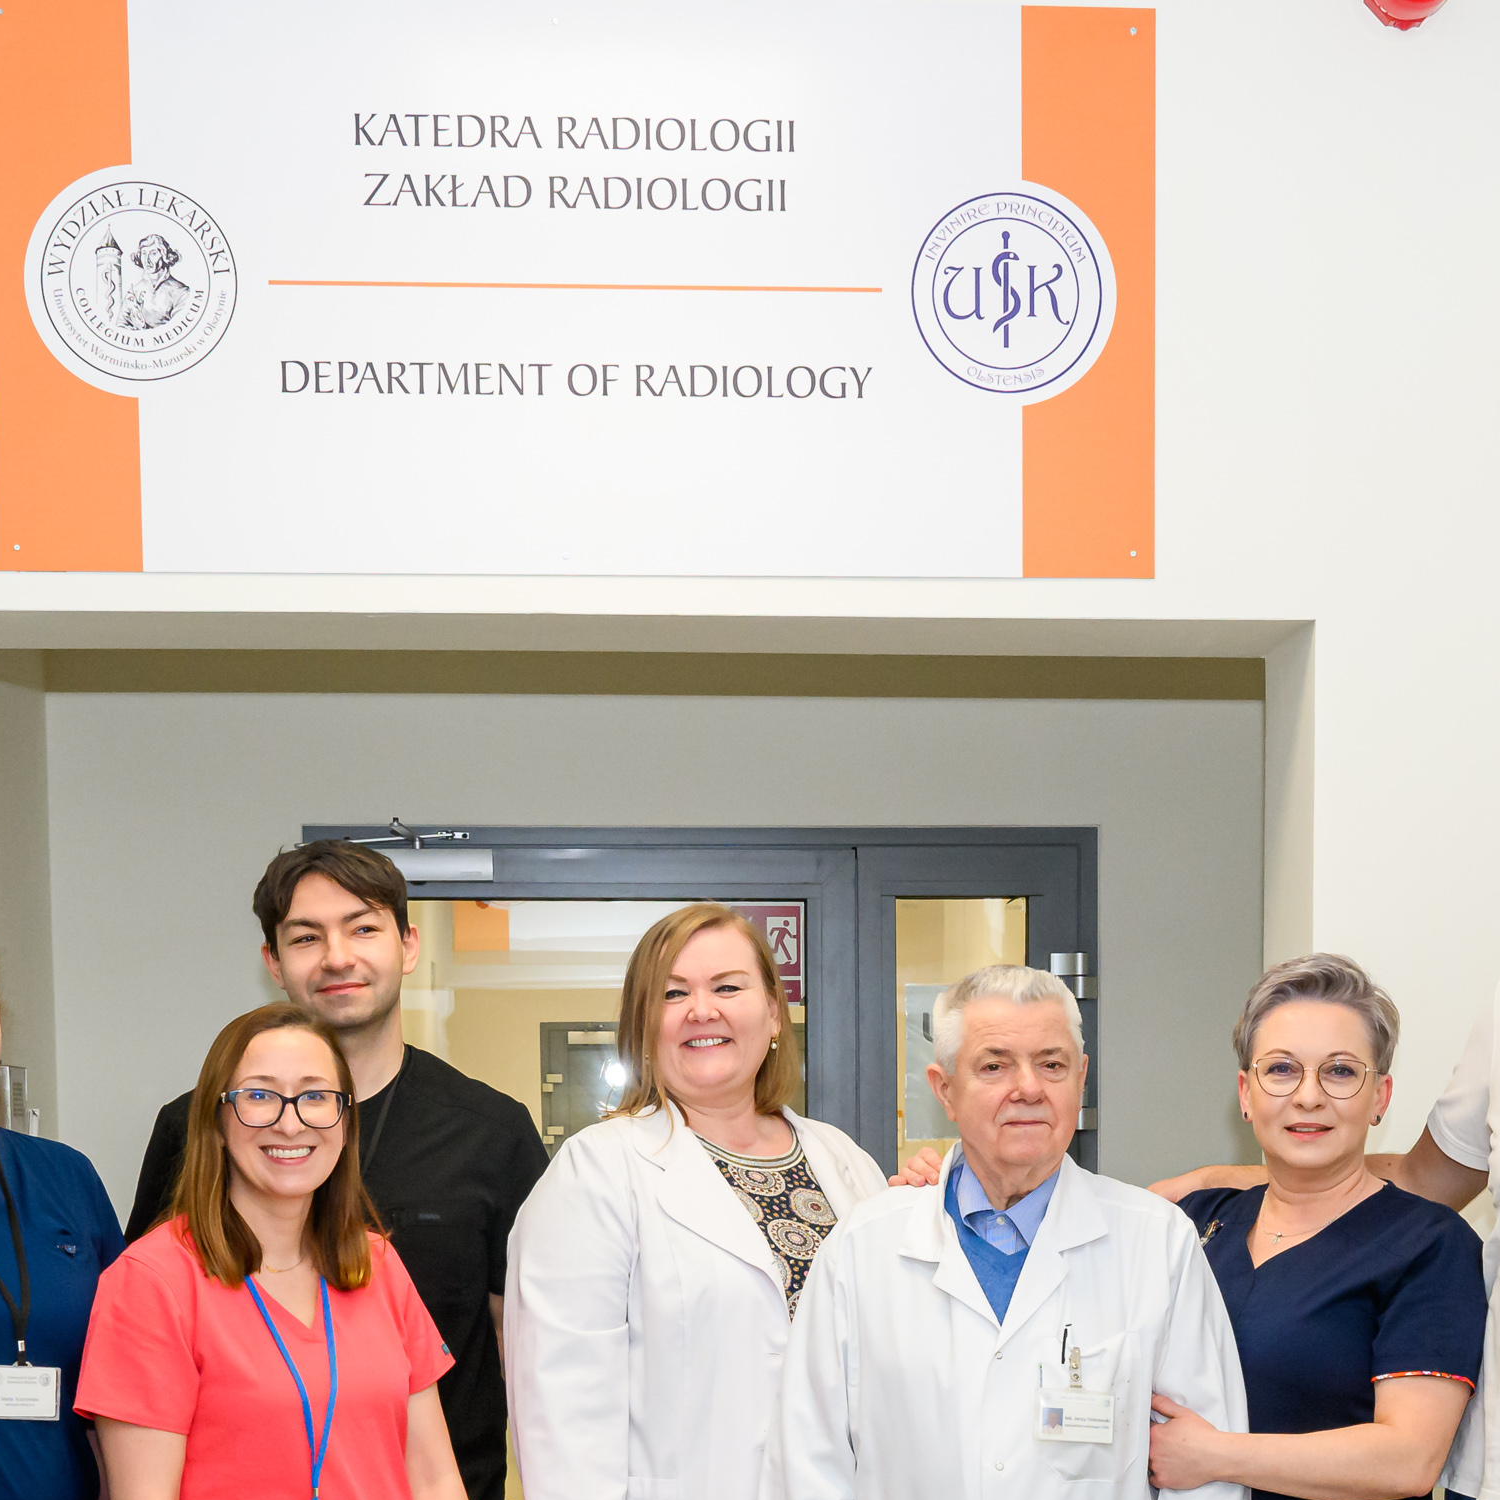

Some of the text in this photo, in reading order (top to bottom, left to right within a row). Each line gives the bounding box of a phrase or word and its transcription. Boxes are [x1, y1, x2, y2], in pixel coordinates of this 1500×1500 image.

[354, 113, 796, 154] KATEDRA RADIOLOGII
[363, 173, 787, 213] ZAKŁAD RADIOLOGII
[47, 188, 231, 276] WYDZIAŁ LEKARSKI
[53, 288, 89, 348] Uniwersytet
[204, 289, 228, 337] Olsztynie
[76, 287, 204, 347] COLLEGIUM MEDICUM
[280, 360, 874, 400] DEPARTMENT OF RADIOLOGY
